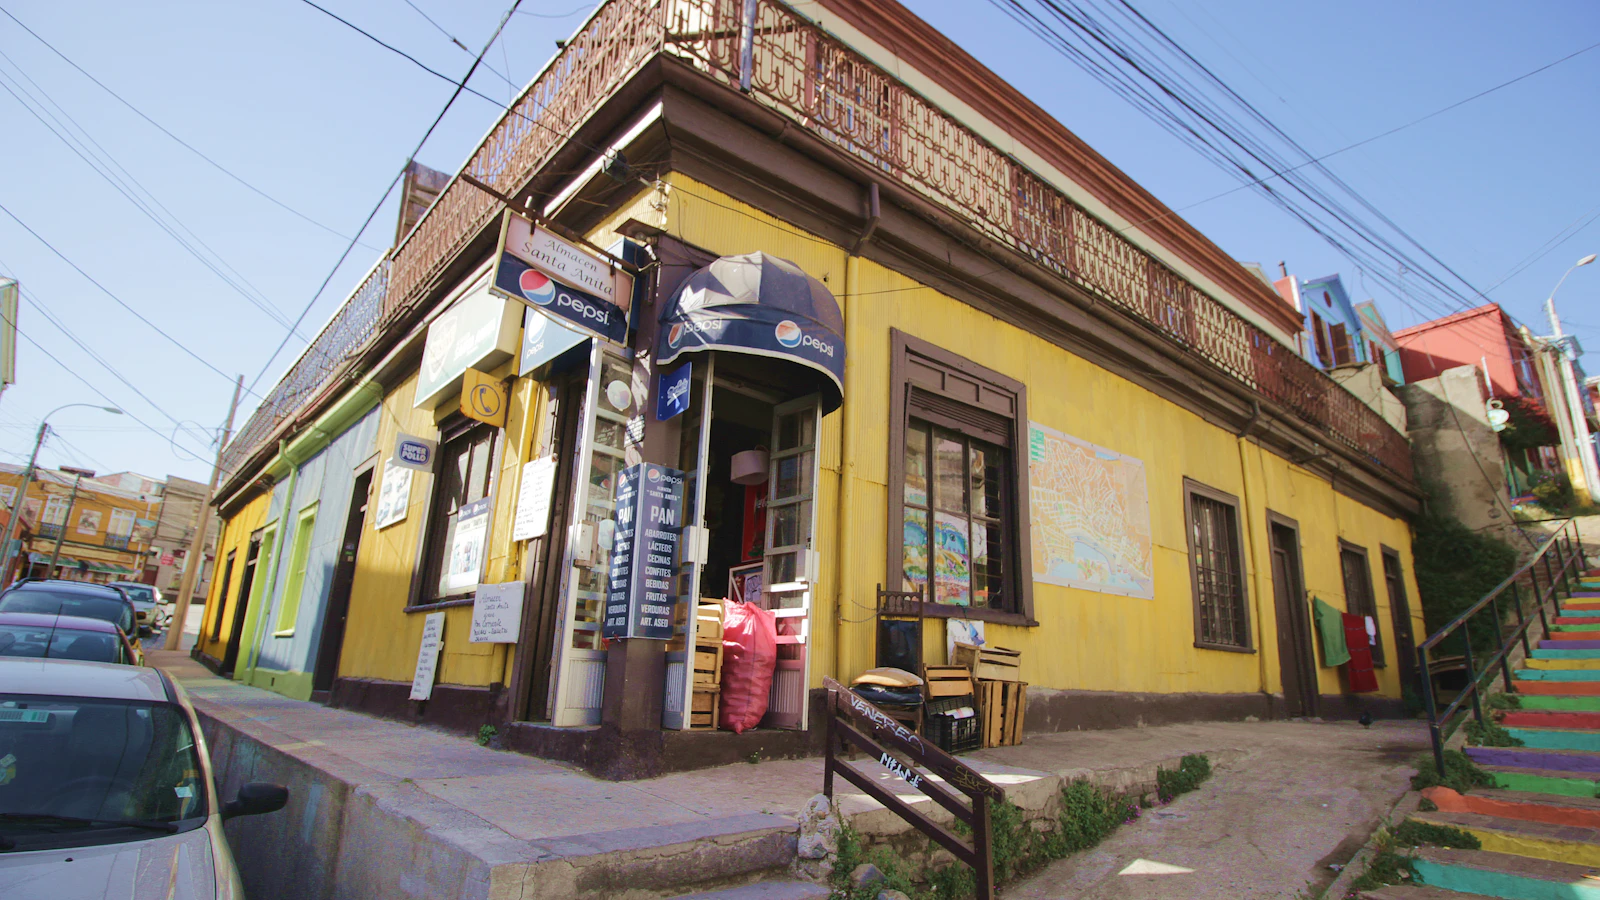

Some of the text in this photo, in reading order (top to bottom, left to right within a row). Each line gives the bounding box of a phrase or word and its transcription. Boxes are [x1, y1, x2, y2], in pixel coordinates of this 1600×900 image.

[544, 239, 598, 272] Almacen
[521, 241, 614, 297] Santa Anita
[557, 293, 609, 326] pepsi
[683, 319, 722, 336] pepsi
[802, 334, 834, 358] pepsi
[403, 443, 427, 456] SUPER
[402, 451, 427, 462] POLLO
[660, 474, 683, 485] pepsi
[618, 506, 633, 525] PAN
[651, 506, 675, 525] PAN
[645, 529, 677, 541] ABARROTES
[648, 541, 672, 553] LÁCTEOS
[648, 554, 671, 565] CECINAS
[645, 566, 672, 578] CONFITES
[645, 579, 669, 590] BEBIDAS
[646, 592, 667, 602] FRUTAS
[641, 604, 670, 615] VERDURAS
[640, 617, 669, 628] ART. ASEO
